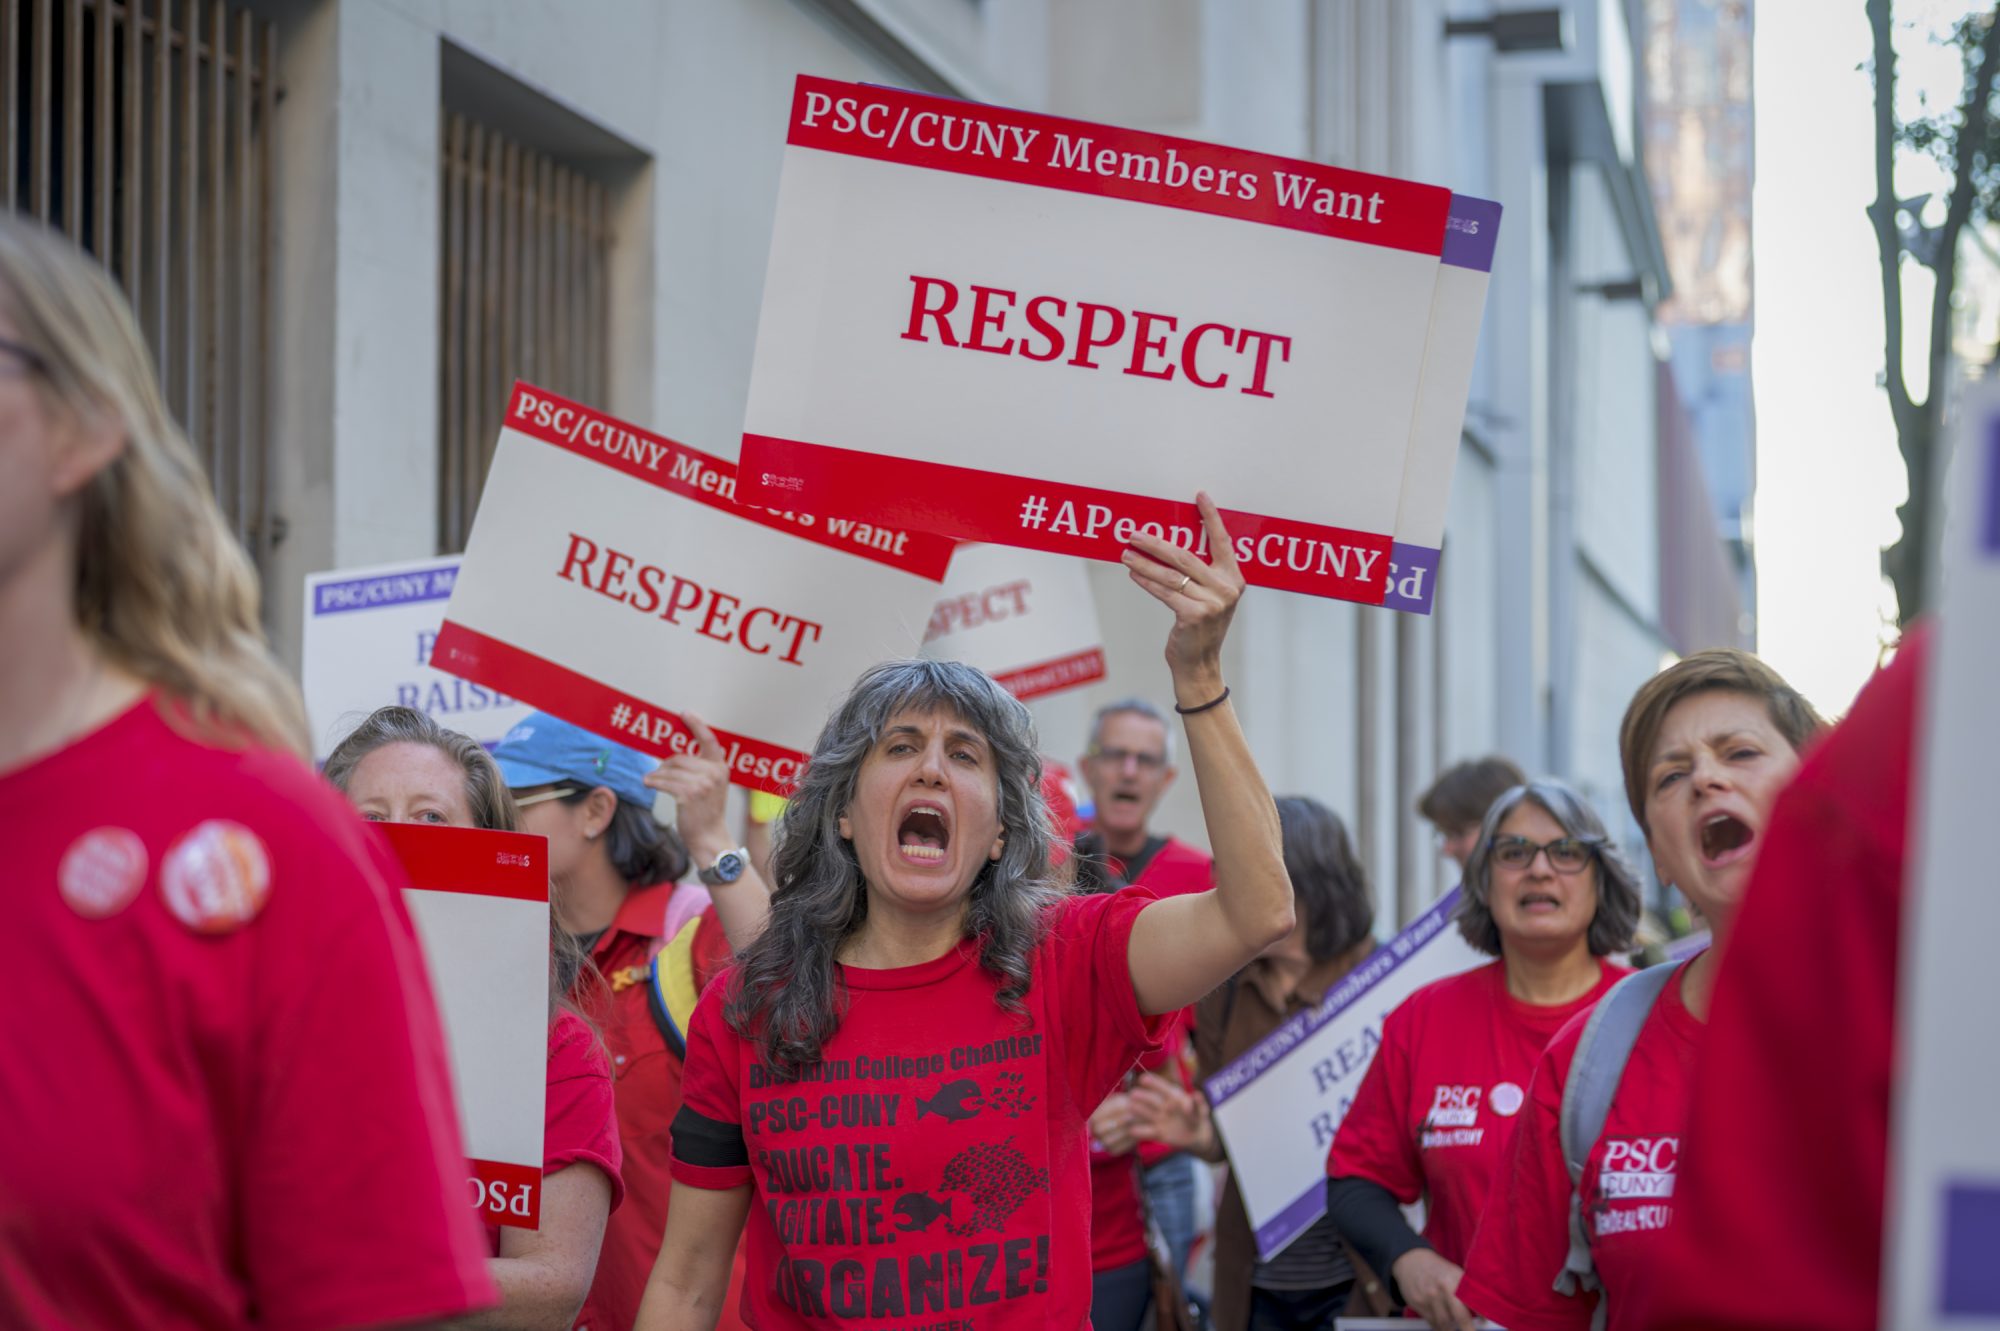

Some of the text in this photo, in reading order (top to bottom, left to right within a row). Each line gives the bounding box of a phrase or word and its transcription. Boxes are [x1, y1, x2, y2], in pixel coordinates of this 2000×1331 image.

[801, 91, 1385, 224] PSC/CUNY Members Want
[900, 275, 1292, 398] RESPECT
[515, 391, 668, 471] PSC/CUNY
[556, 532, 821, 666] RESPECT
[855, 1055, 945, 1081] College
[950, 1034, 1043, 1071] Chapter
[749, 1094, 900, 1135] PSC-CUNY
[1434, 1085, 1482, 1110] PSC
[1601, 1137, 1679, 1174] PSC
[1606, 1175, 1665, 1194] CUNY
